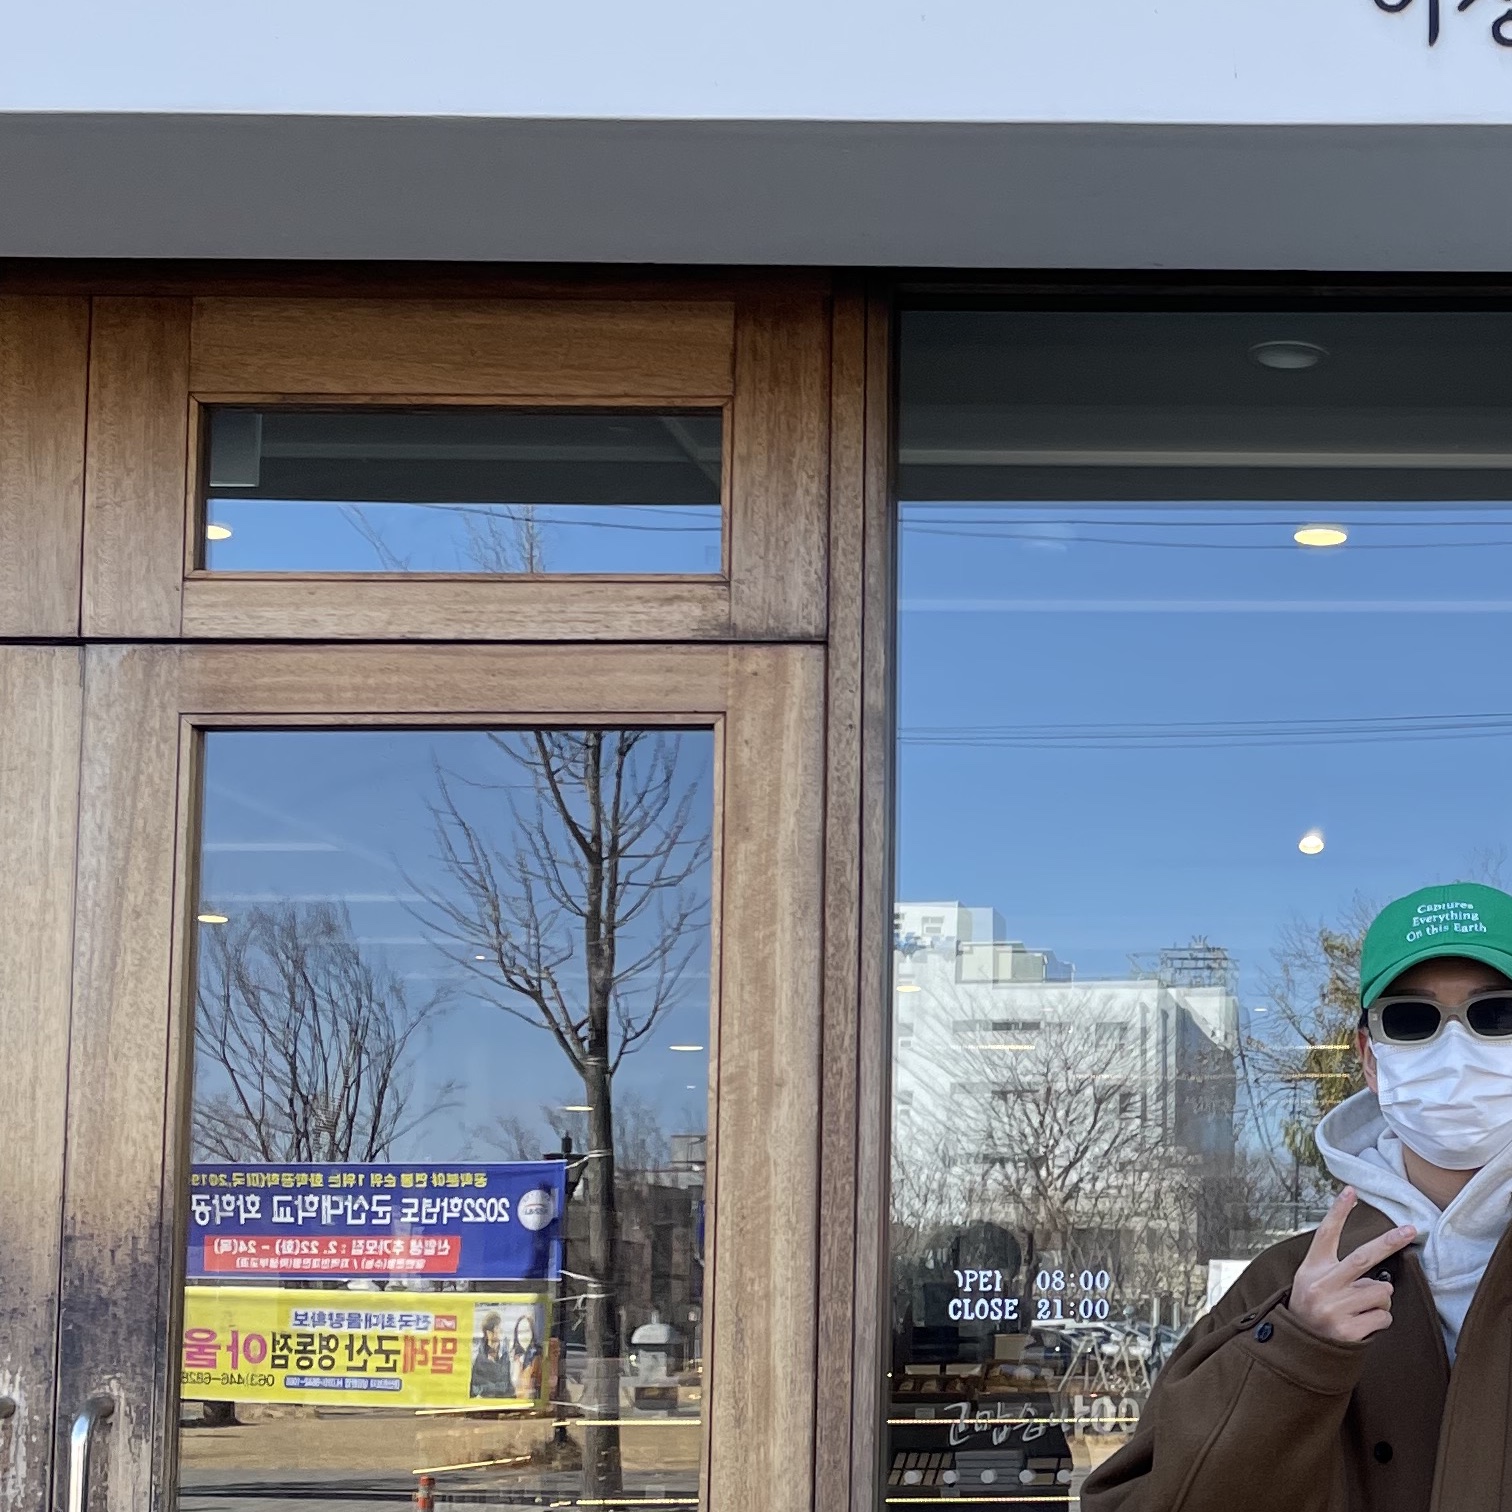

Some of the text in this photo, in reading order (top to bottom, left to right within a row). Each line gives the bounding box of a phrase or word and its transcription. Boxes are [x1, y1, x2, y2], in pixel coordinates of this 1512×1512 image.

[1416, 901, 1474, 914] Captures
[1412, 911, 1480, 927] Everything
[1405, 922, 1487, 942] On this Earth
[1036, 1270, 1111, 1291] 08:00
[948, 1298, 1110, 1321] CLOSE 21:00
